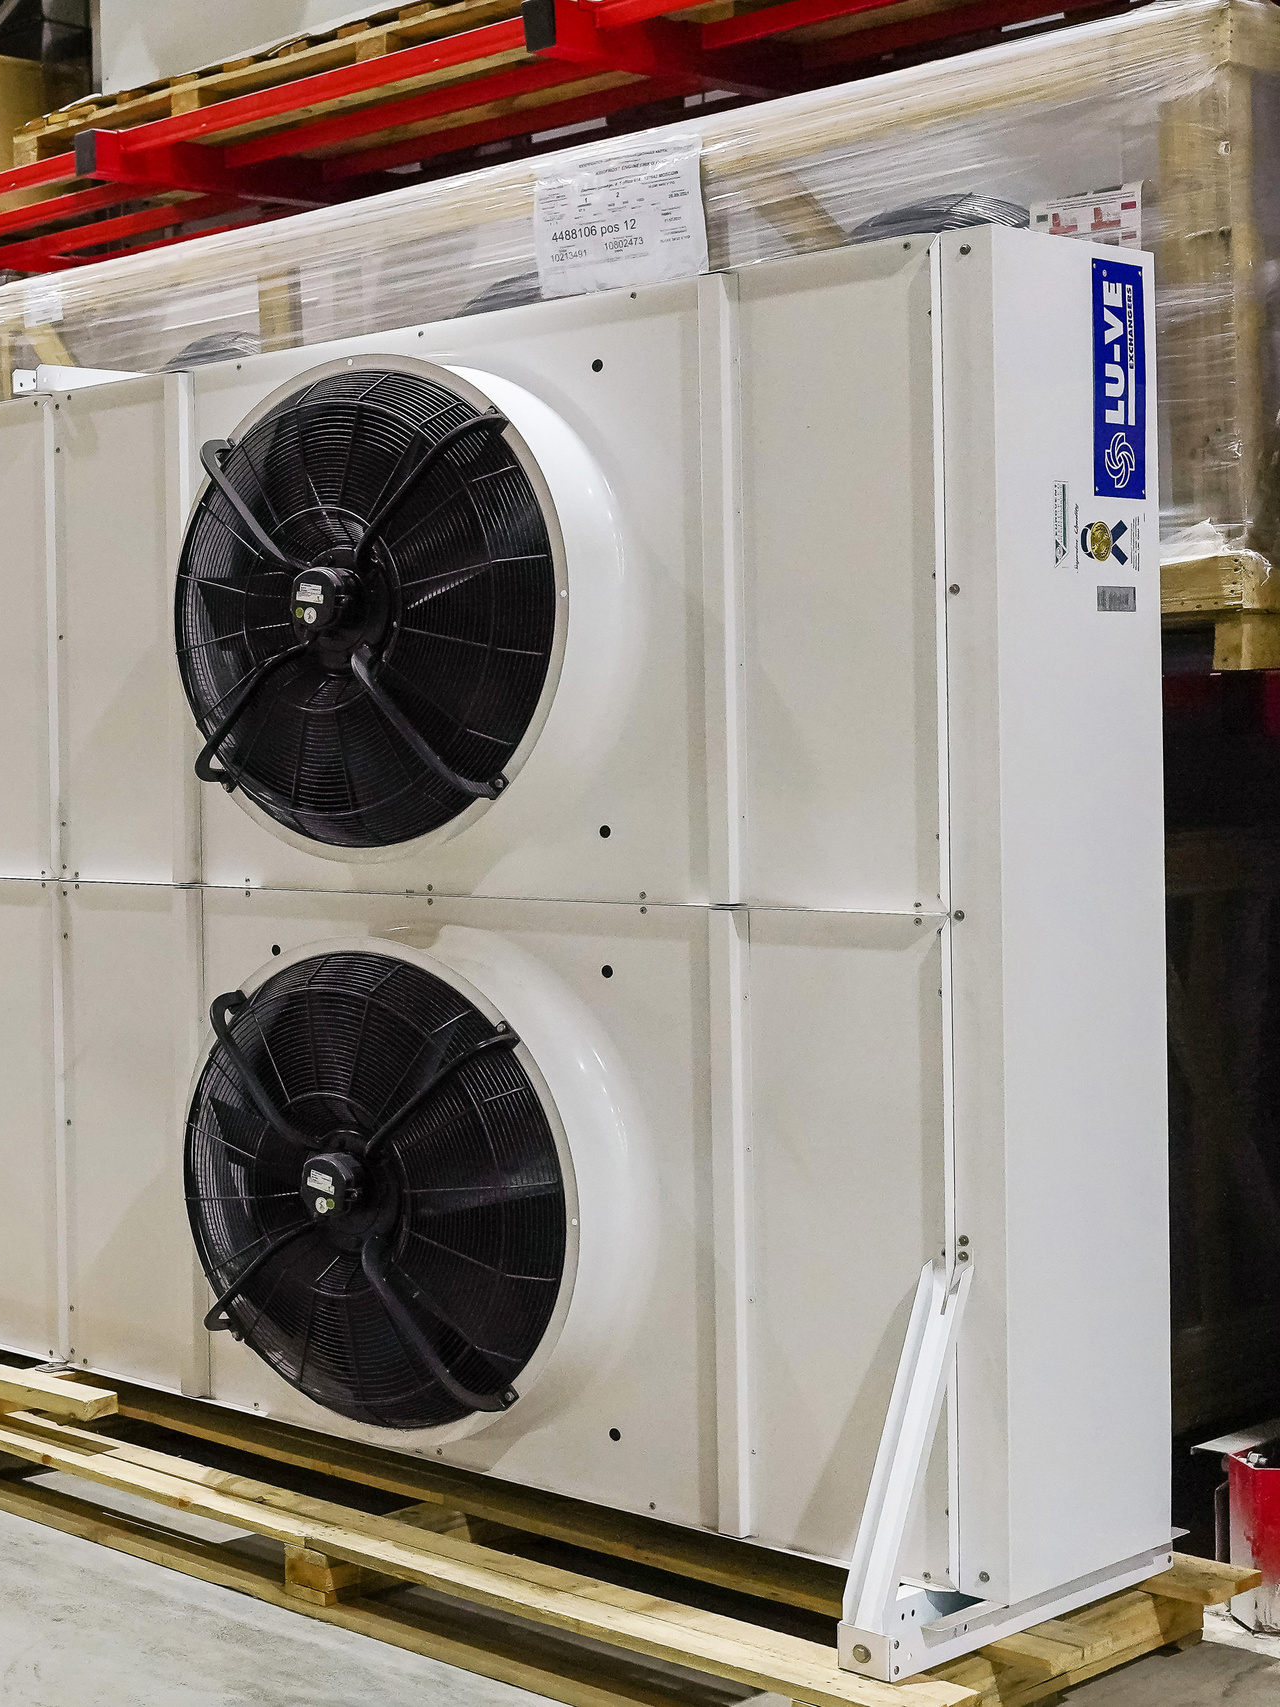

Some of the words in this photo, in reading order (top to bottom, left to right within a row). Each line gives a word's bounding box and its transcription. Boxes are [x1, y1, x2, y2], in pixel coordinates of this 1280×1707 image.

[552, 225, 597, 242] 4488106
[600, 223, 620, 237] pos
[623, 218, 636, 230] 12
[604, 236, 644, 250] 10802473
[551, 249, 587, 262] 10213491
[1127, 287, 1135, 370] EXCHANGERS
[1103, 280, 1125, 425] LU-VE
